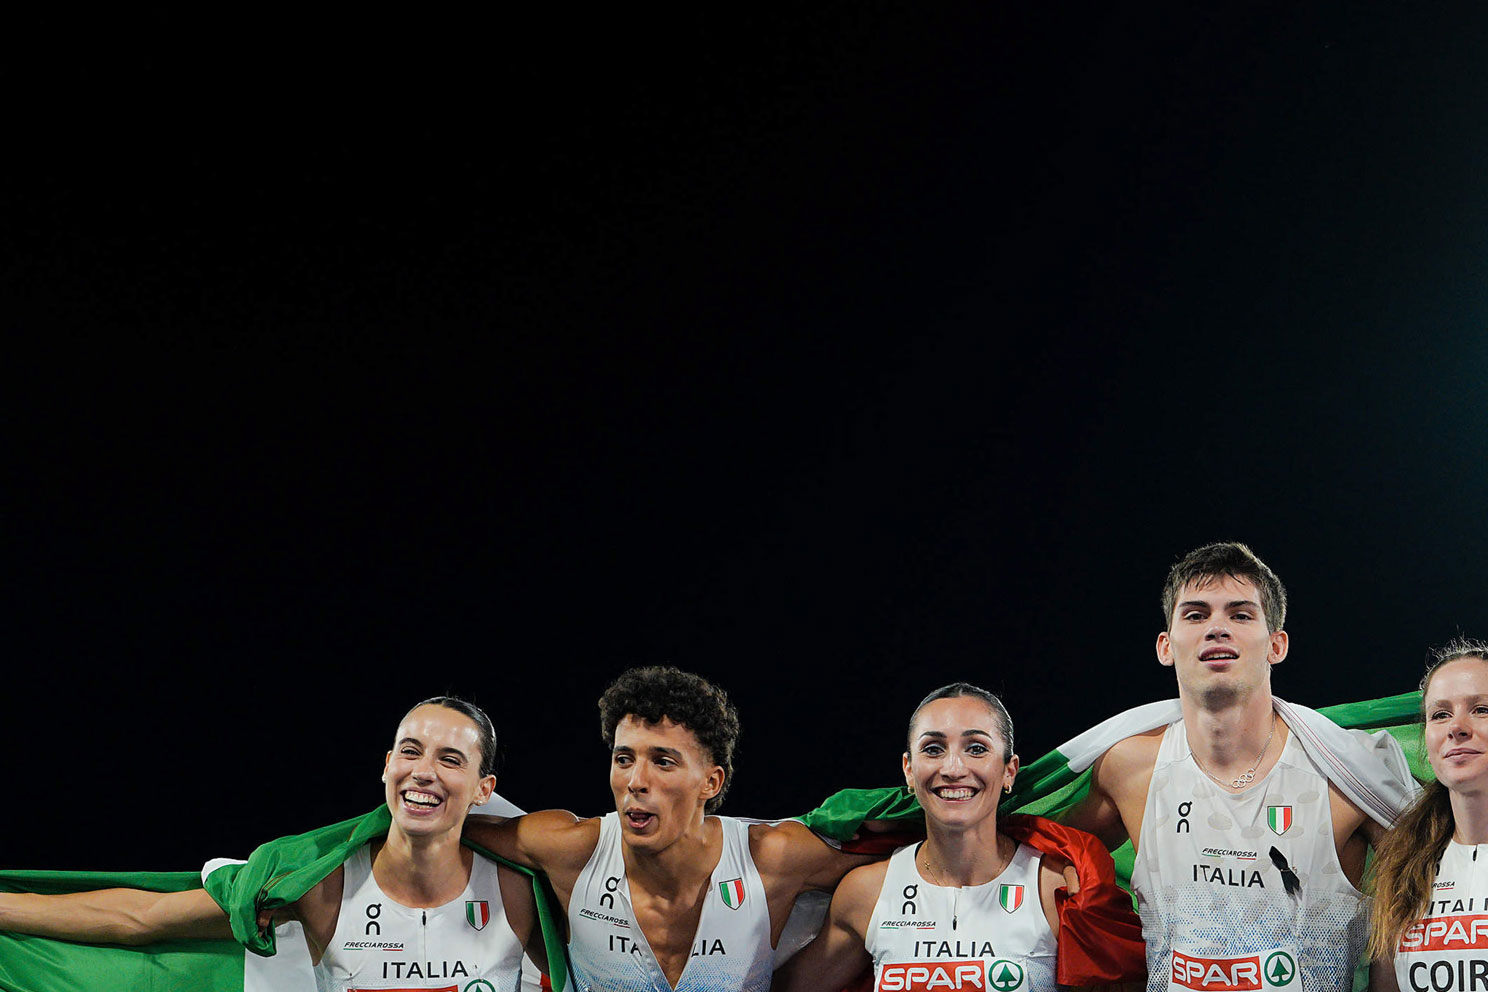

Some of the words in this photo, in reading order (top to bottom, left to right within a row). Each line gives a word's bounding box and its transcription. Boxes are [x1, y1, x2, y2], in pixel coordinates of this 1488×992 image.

[1193, 864, 1265, 888] ITALIA
[580, 908, 630, 925] FRECCIAROSS
[914, 941, 995, 958] ITALIA
[382, 960, 469, 979] ITALIA
[882, 965, 983, 991] SPAR
[1173, 956, 1259, 986] SPAR
